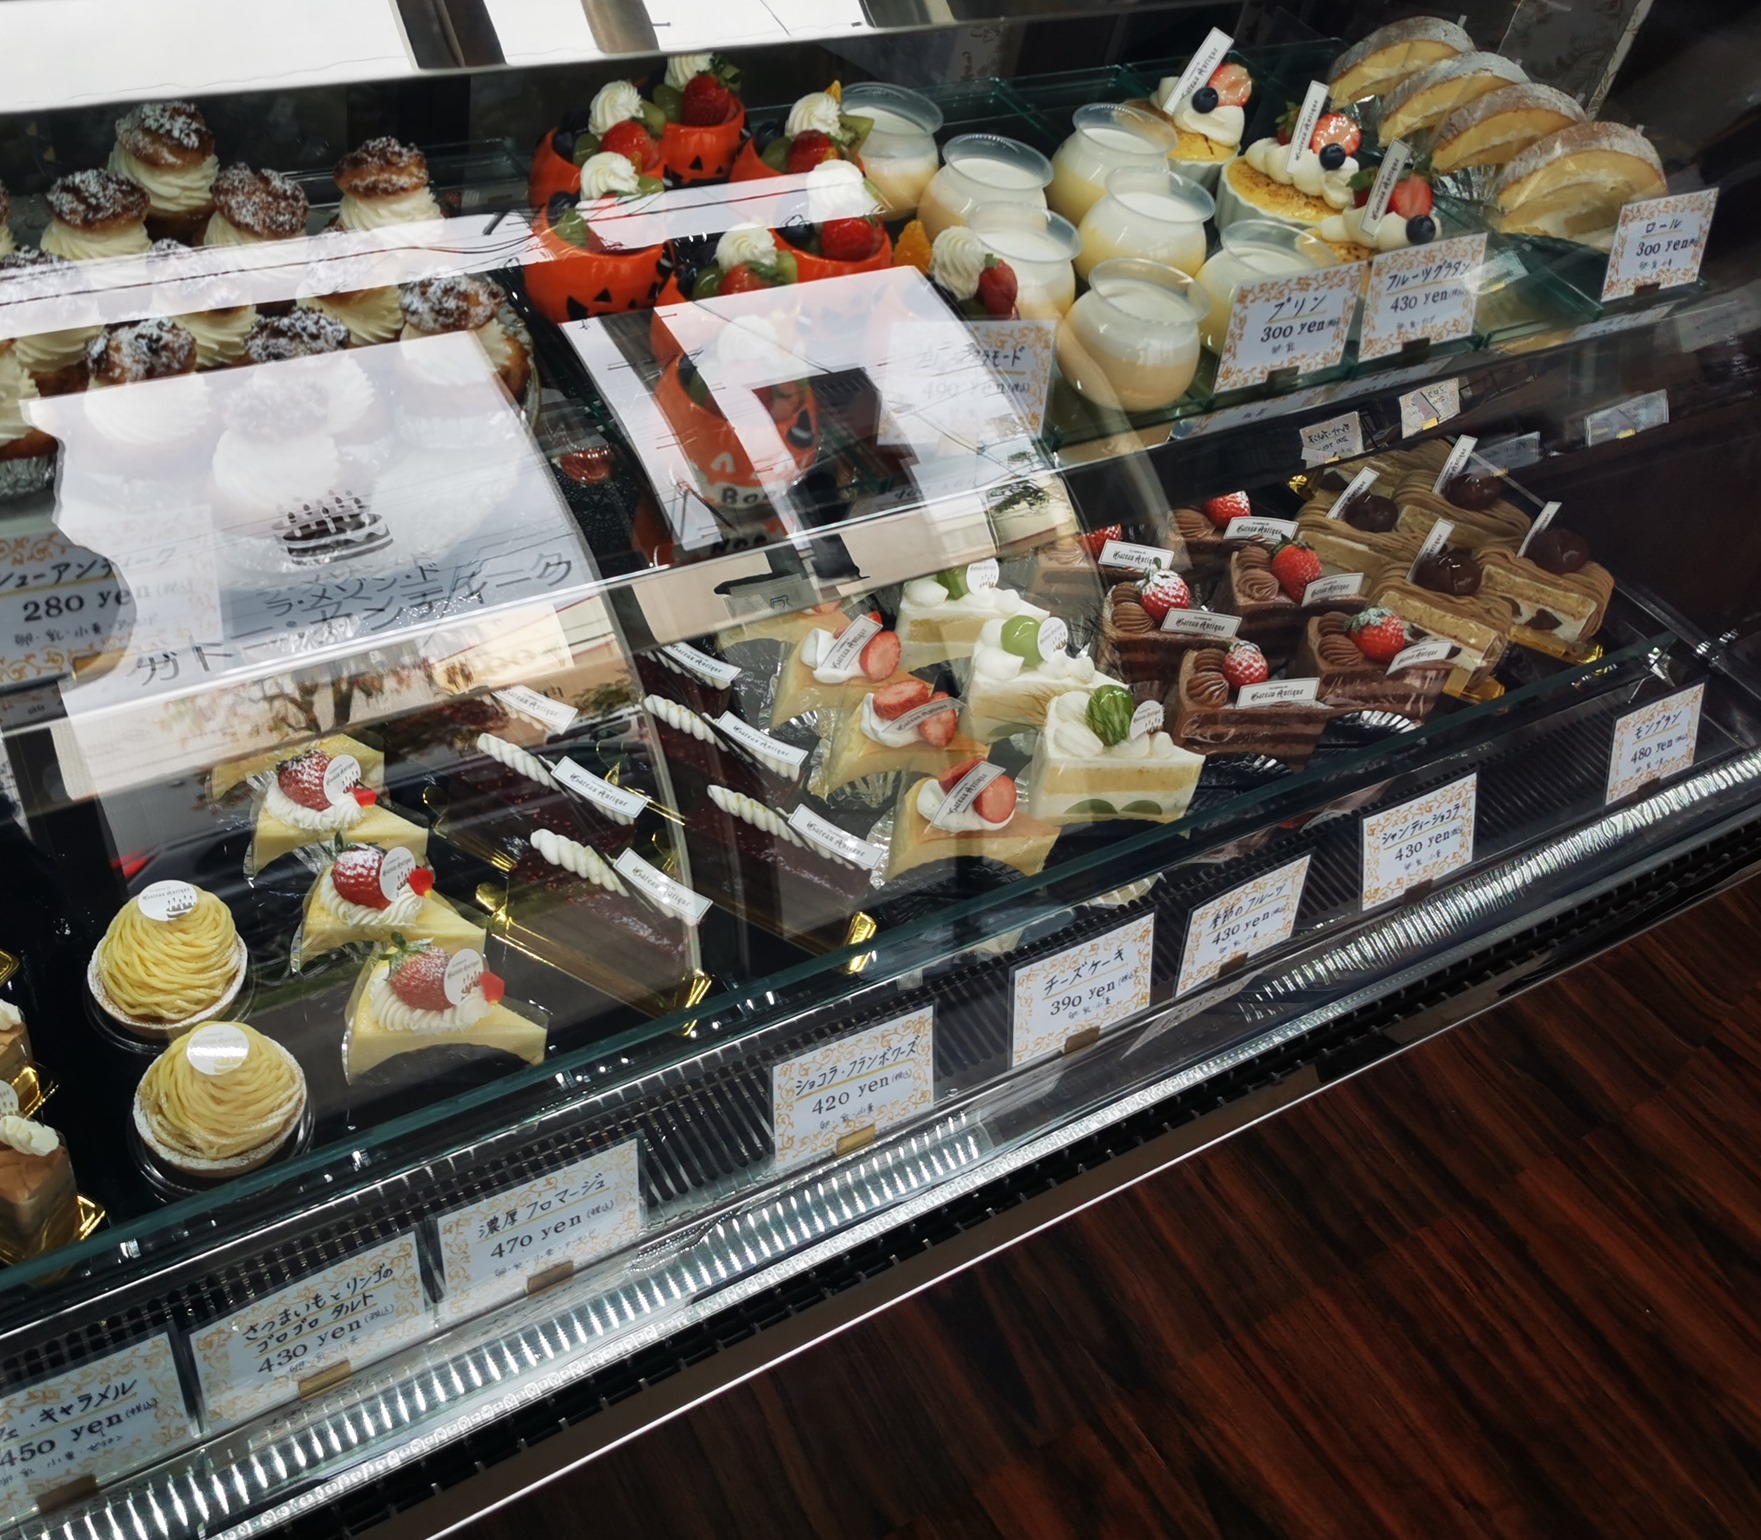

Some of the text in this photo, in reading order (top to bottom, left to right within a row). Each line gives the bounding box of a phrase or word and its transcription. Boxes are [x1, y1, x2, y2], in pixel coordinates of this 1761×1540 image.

[1645, 218, 1683, 233] ロール
[1636, 242, 1660, 256] 300
[1665, 239, 1690, 252] yen
[1386, 260, 1470, 291] フルーツグラタン
[1268, 294, 1327, 321] プリン
[1390, 295, 1418, 313] 430
[1423, 289, 1448, 305] yen
[1260, 325, 1294, 342] 300
[1297, 320, 1324, 335] yen
[22, 594, 85, 622] 280
[97, 585, 152, 608] yen
[1635, 710, 1683, 740] モンブラン
[1630, 740, 1673, 764] 480 yen
[1394, 841, 1423, 861] 430
[1427, 830, 1450, 848] yen
[1212, 924, 1241, 945] 430
[1244, 909, 1270, 932] yen
[1044, 948, 1126, 996] チーズケーキ
[1050, 996, 1082, 1016] 390
[1088, 981, 1116, 1000] yen
[795, 1035, 920, 1096] ショコラ・フランボワーズ
[812, 1091, 849, 1115] 420
[858, 1076, 889, 1097] yen
[490, 1235, 533, 1258] 470
[541, 1214, 582, 1240] yen
[243, 1262, 394, 1341] さつまいもとリンゴの
[331, 1292, 375, 1320] タルト
[257, 1344, 308, 1374] 430
[317, 1319, 362, 1347] yen
[0, 1439, 56, 1468] 450
[70, 1411, 123, 1442] yen
